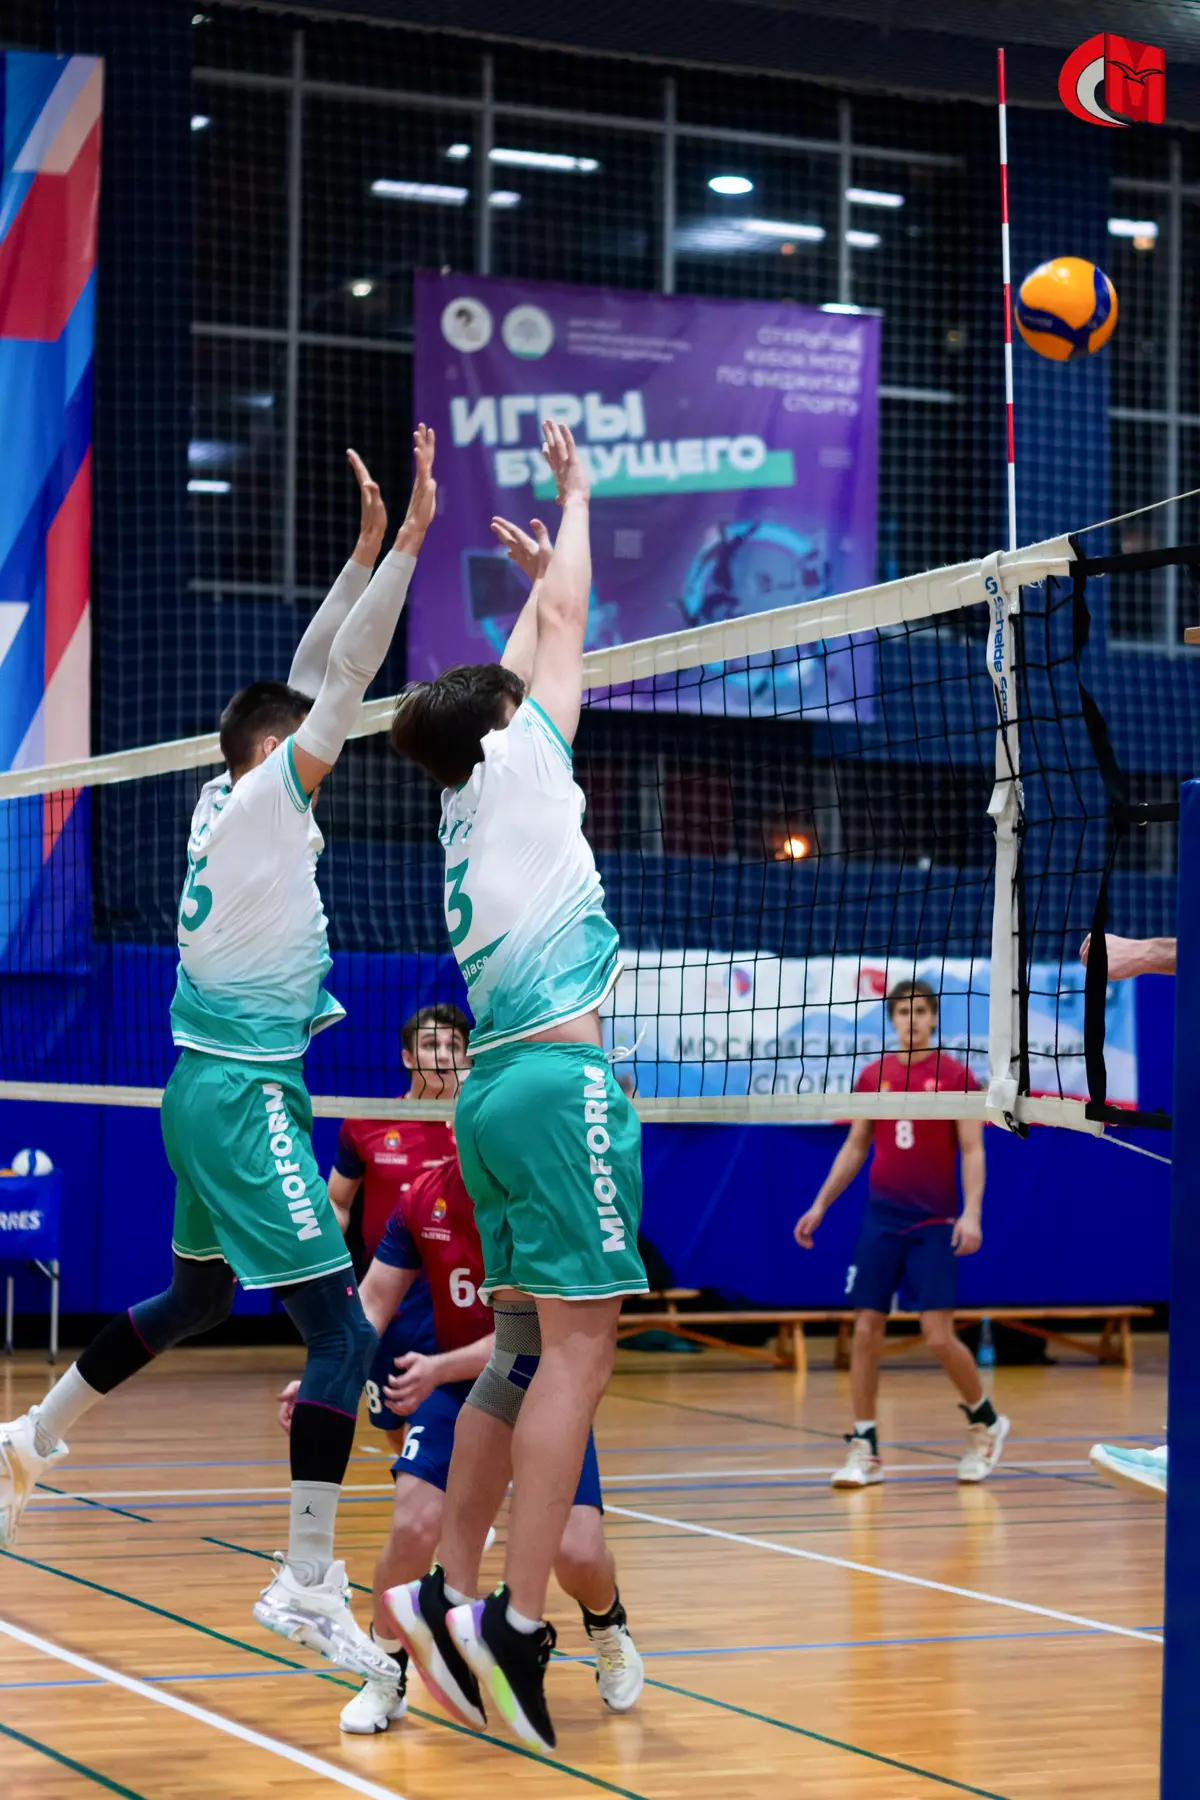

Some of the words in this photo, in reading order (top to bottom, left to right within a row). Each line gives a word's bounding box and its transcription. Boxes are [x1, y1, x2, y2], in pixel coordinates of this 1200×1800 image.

[451, 391, 646, 446] ИГРЫ
[675, 1035, 872, 1062] МОСКОВСКИЕ
[895, 1119, 915, 1150] 8
[262, 1082, 322, 1242] MIOFORM
[583, 1065, 626, 1252] MIOFORM
[449, 1267, 476, 1308] 6
[365, 1379, 382, 1414] 8
[401, 1425, 425, 1461] 6
